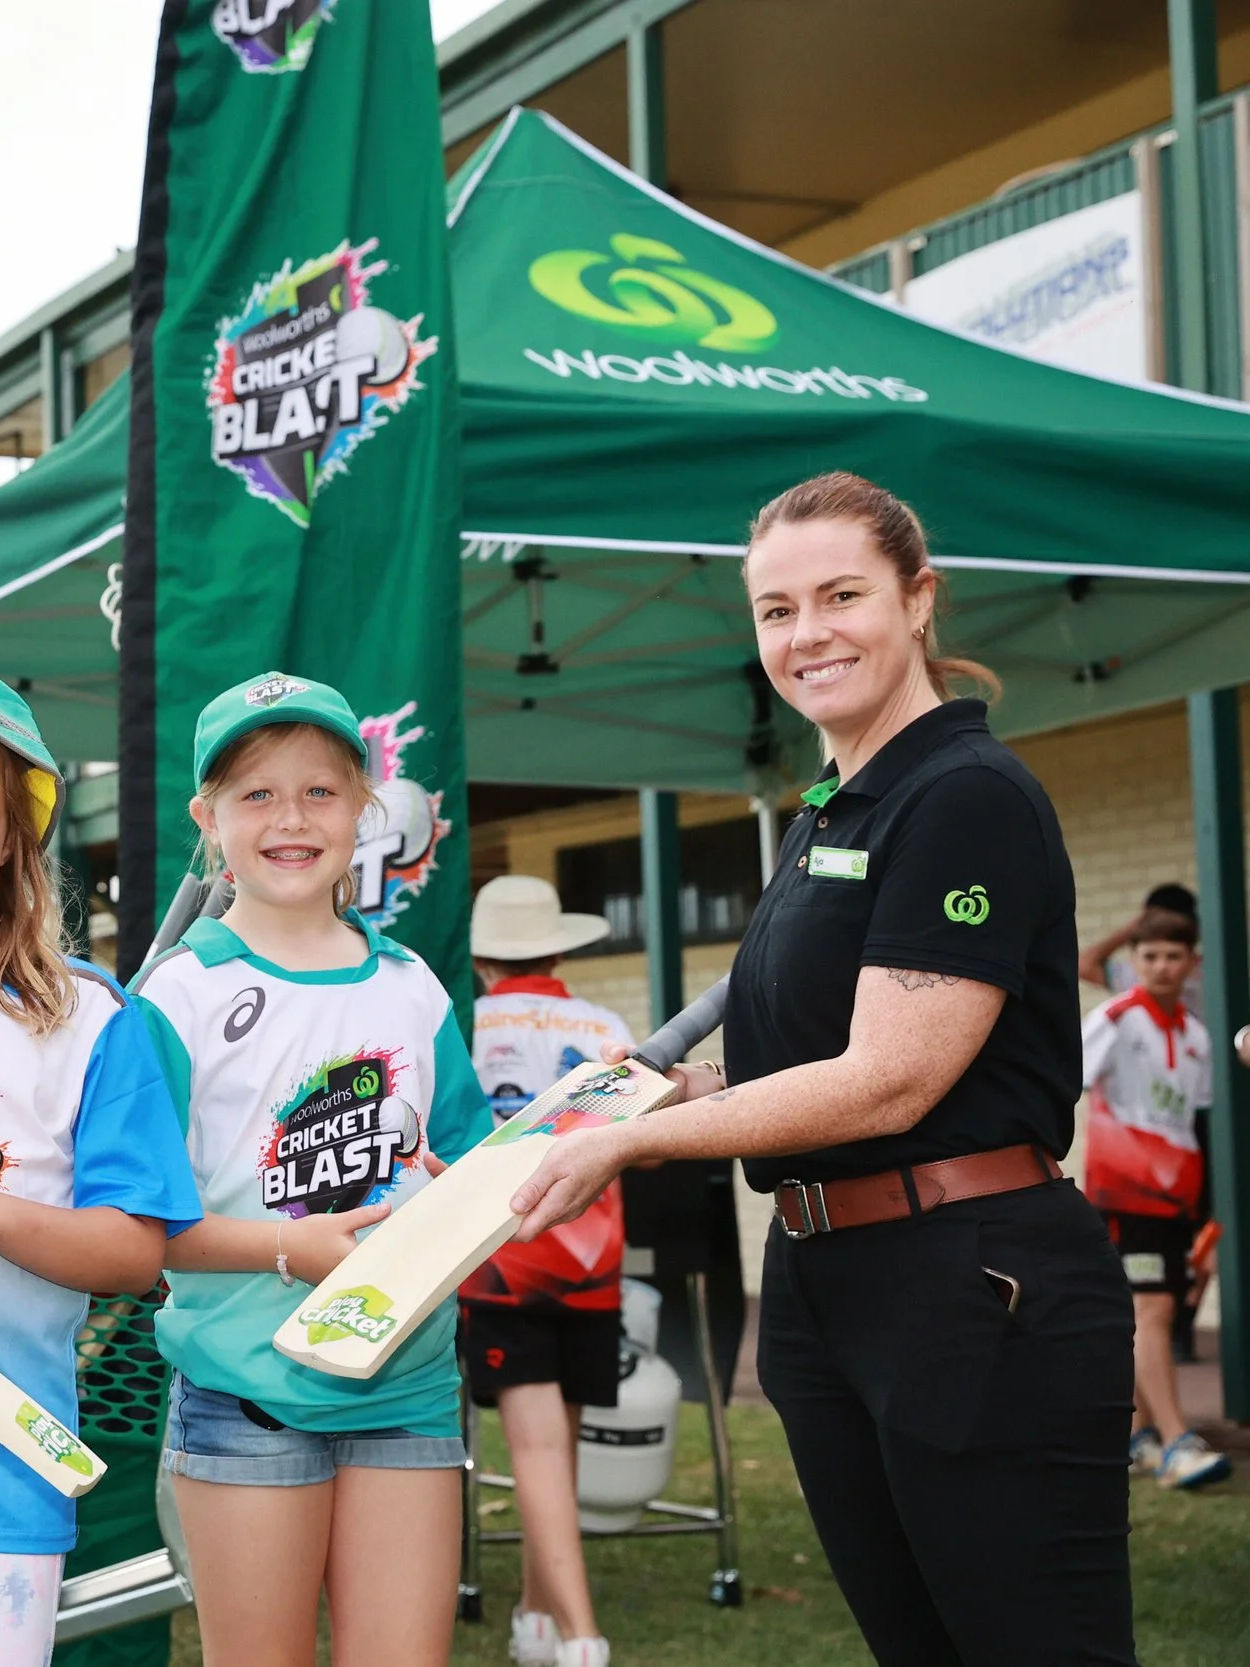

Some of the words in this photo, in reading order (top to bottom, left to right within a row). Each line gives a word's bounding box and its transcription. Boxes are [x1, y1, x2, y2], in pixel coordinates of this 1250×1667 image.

[232, 329, 338, 396] CRICKE
[522, 348, 929, 403] woolworths
[276, 1102, 377, 1159] CRICKET
[291, 1087, 353, 1127] woolworths
[263, 1131, 403, 1205] BLAST
[300, 1306, 392, 1340] cricket
[329, 1295, 366, 1310] play
